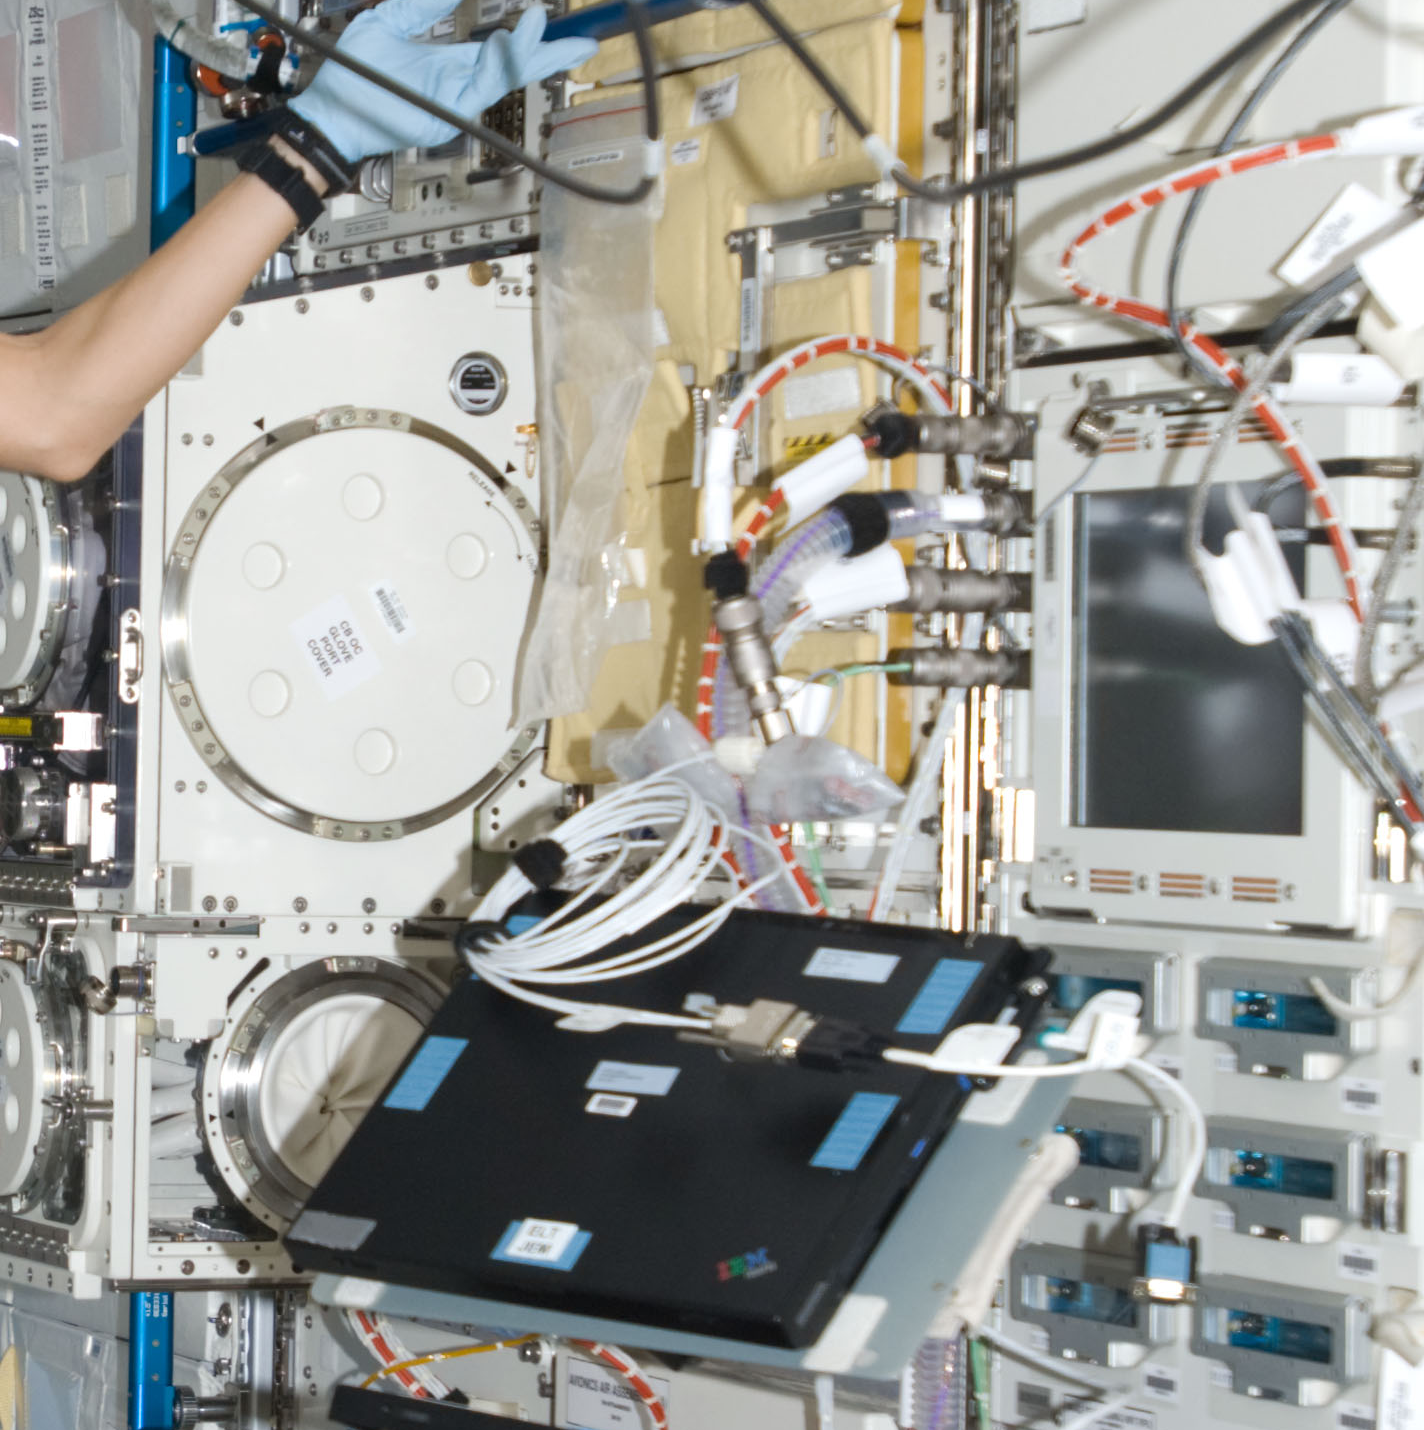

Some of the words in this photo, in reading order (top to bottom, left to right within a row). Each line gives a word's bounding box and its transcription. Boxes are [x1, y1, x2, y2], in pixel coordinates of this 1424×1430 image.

[468, 471, 496, 497] RELEASE
[307, 639, 333, 678] COVER
[319, 636, 341, 665] PORT
[329, 626, 354, 663] GLOVE
[568, 1374, 603, 1392] AVIONICS
[605, 1380, 617, 1394] AIR
